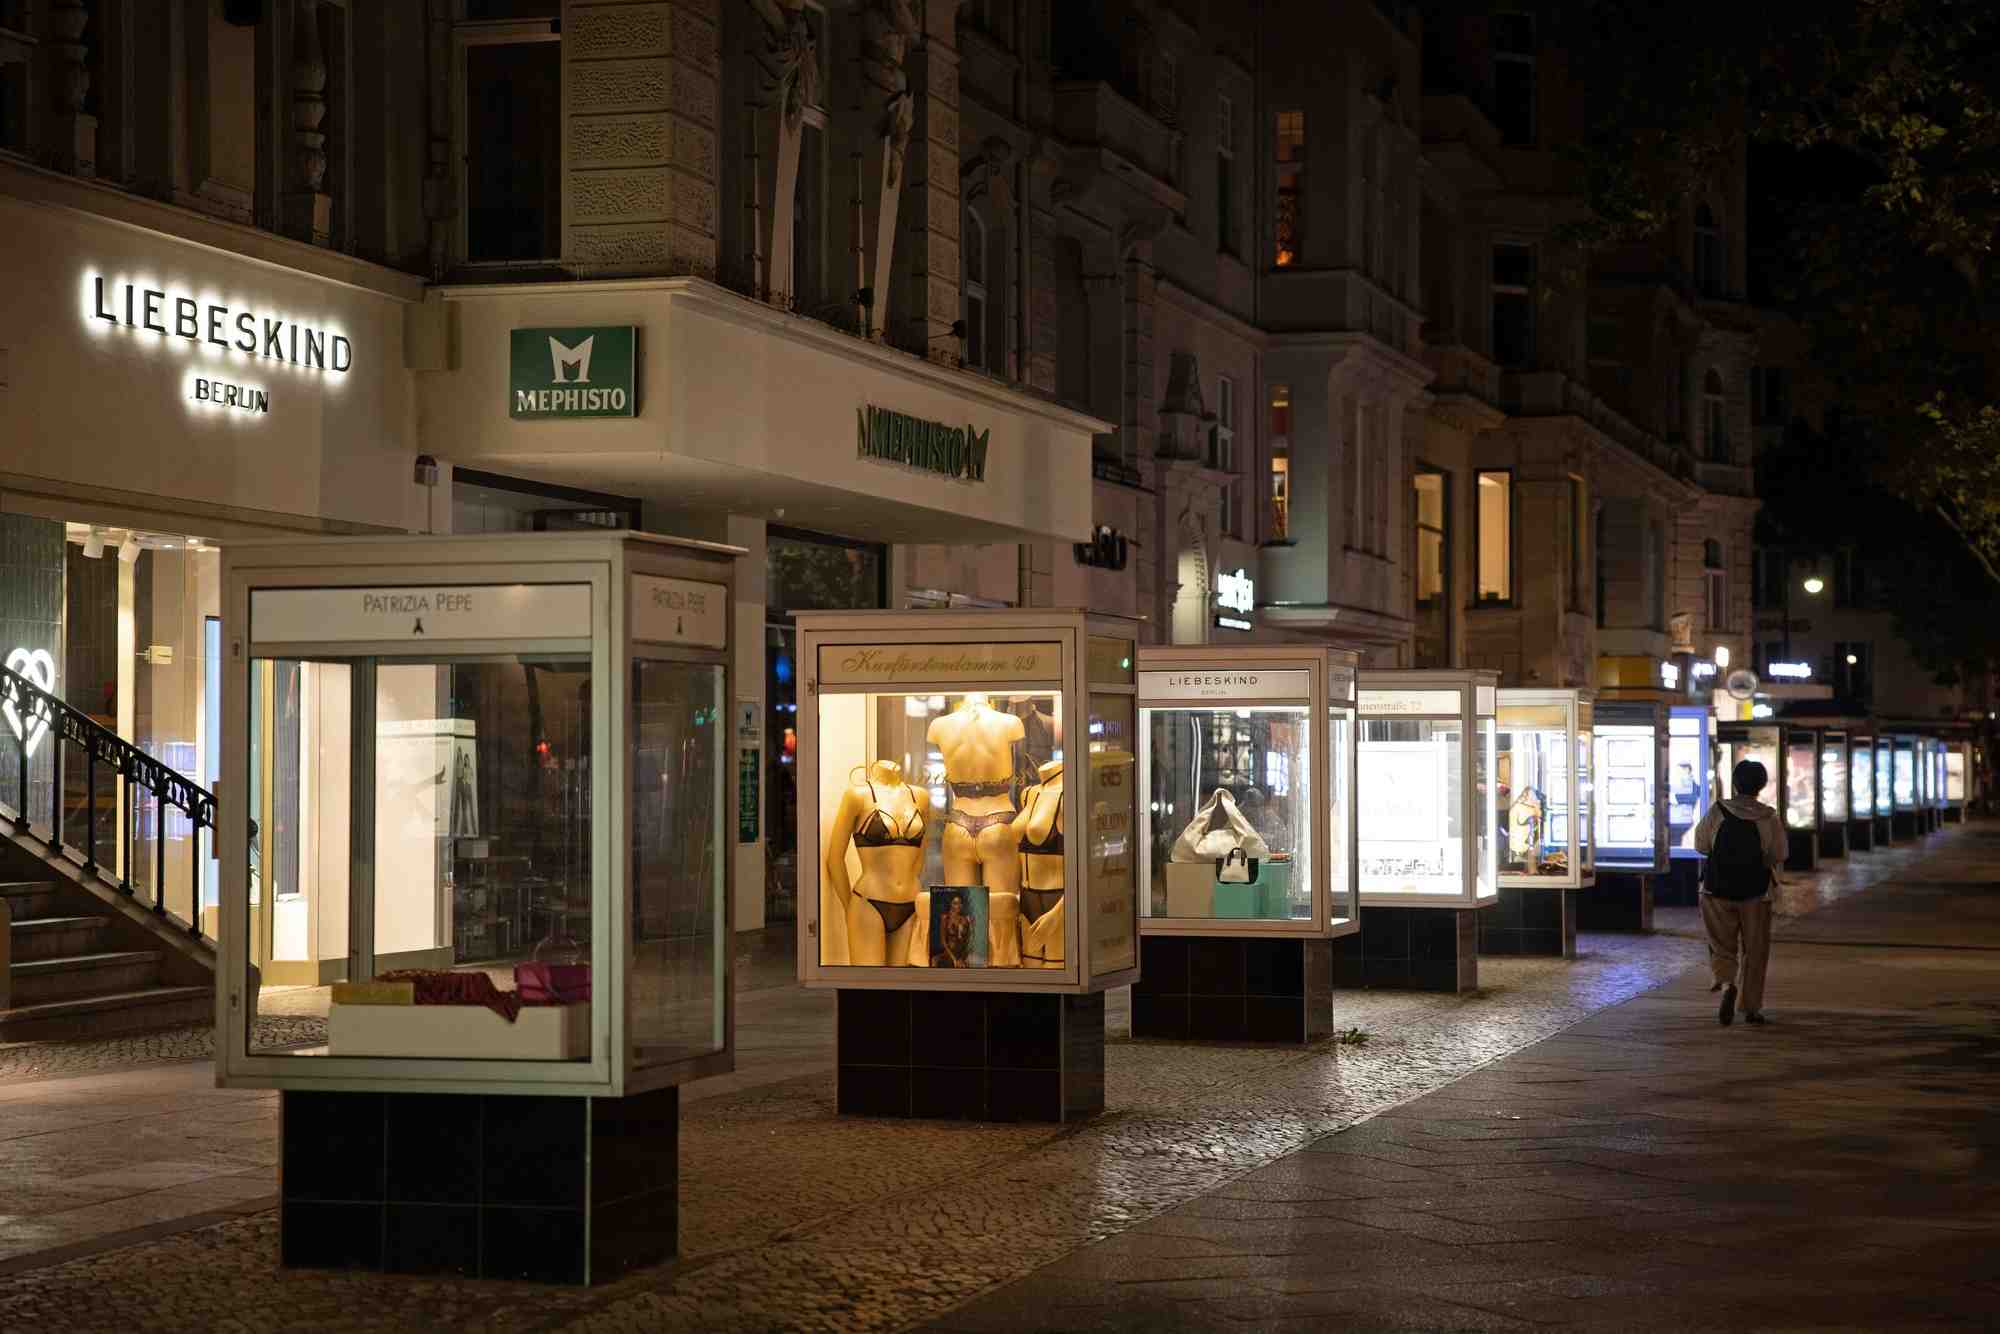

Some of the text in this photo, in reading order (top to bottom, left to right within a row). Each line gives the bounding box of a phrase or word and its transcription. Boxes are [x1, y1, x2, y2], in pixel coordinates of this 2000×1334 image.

[95, 276, 352, 372] LIEBESKIND
[195, 378, 269, 413] BERLIN
[516, 387, 626, 412] MEPHISTO
[872, 406, 966, 480] MEPHISTO
[363, 592, 473, 613] PATRIZIA PEPE
[1169, 675, 1259, 687] LIEBESKIND
